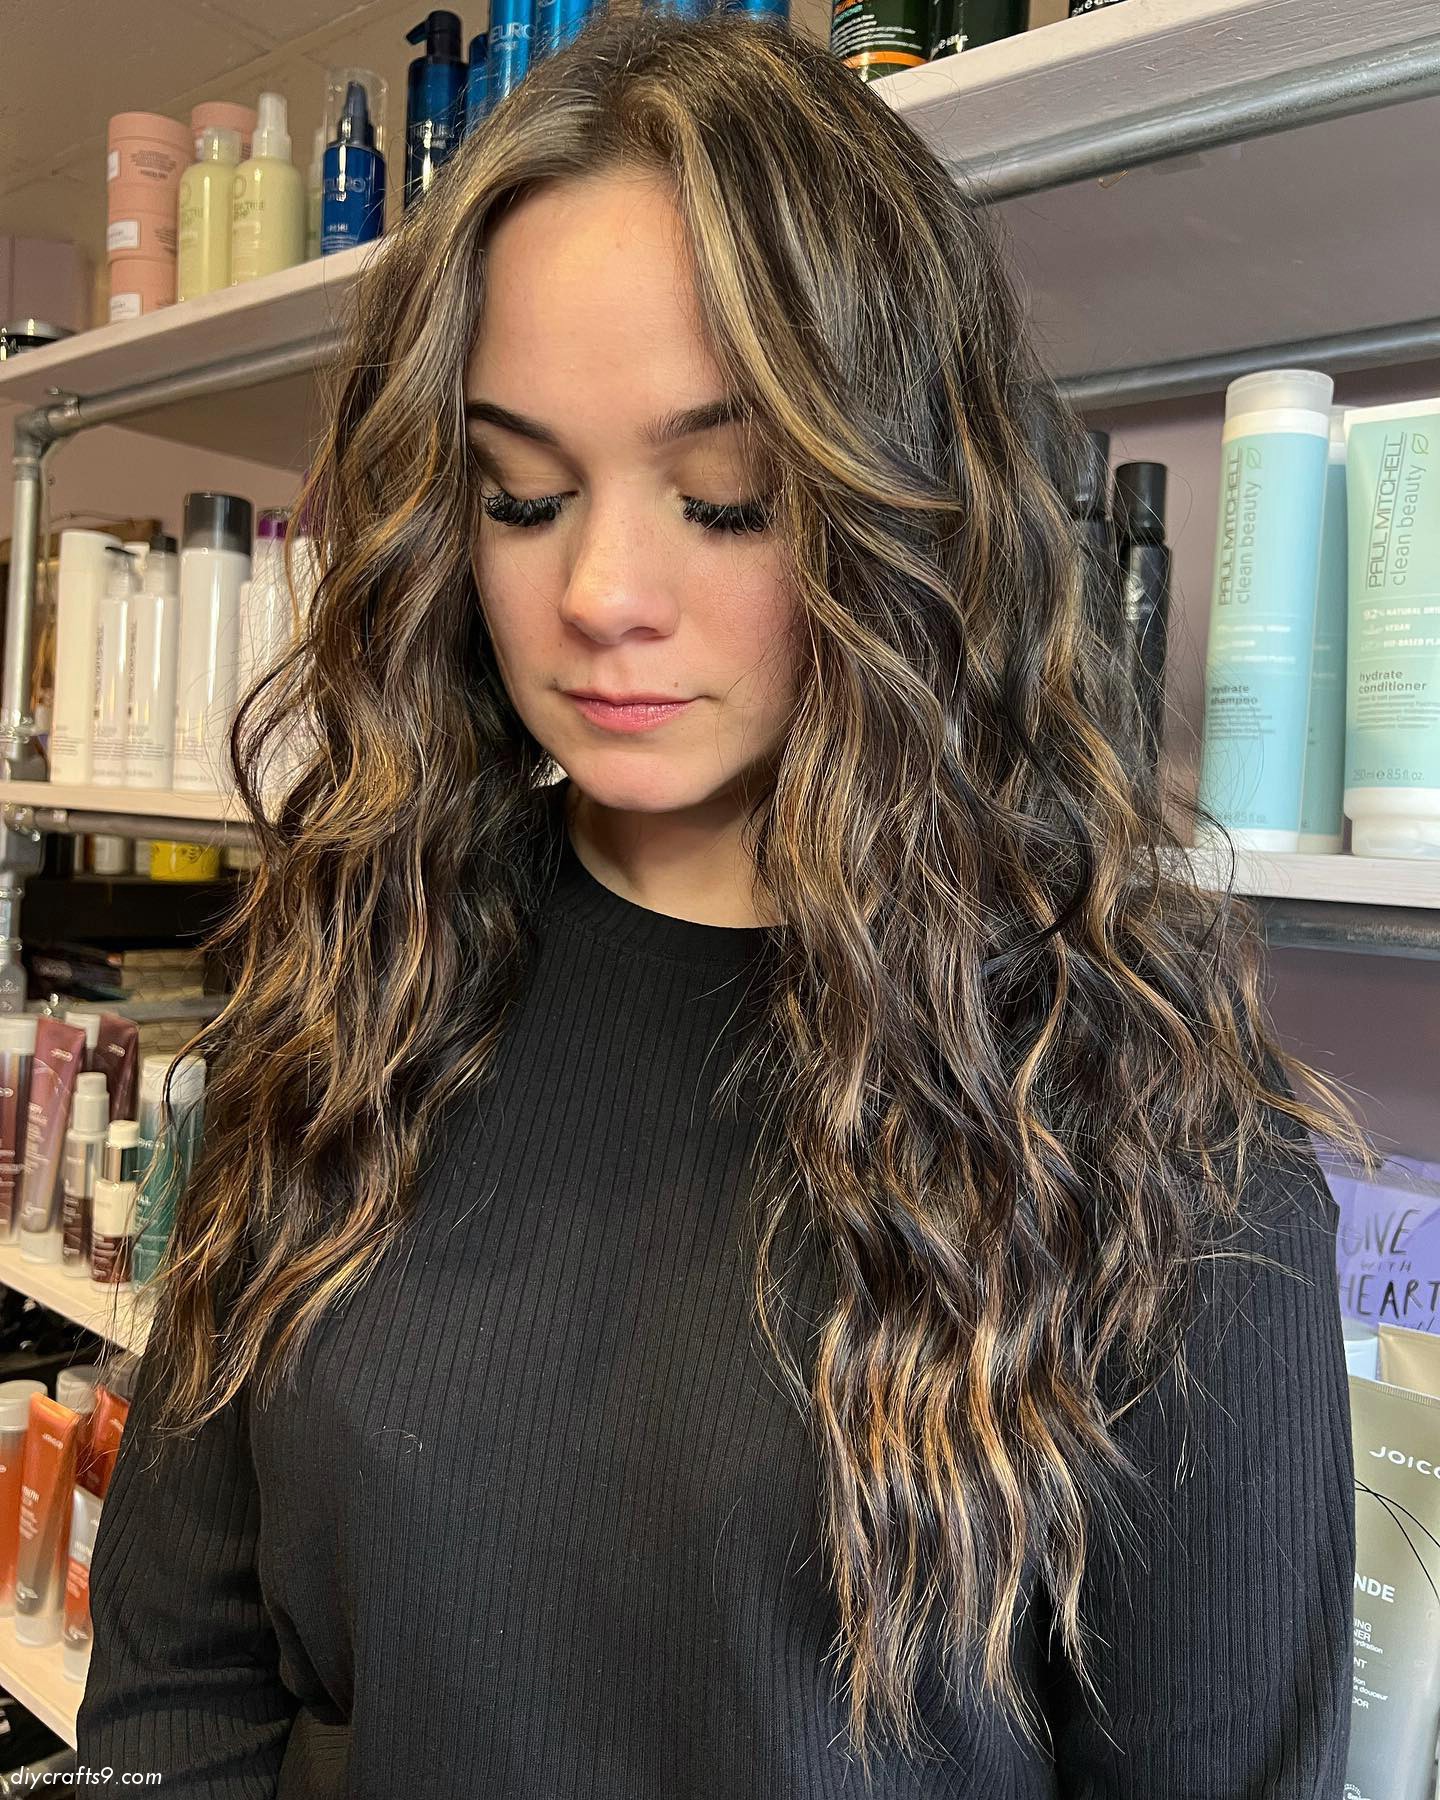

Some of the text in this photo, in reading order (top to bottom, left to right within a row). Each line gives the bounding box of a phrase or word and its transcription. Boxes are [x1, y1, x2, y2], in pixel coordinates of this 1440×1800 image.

[1217, 446, 1241, 606] PAUL MITCHELL
[1236, 481, 1263, 605] clean beauty
[1368, 431, 1405, 588] PAUL MITCHELL
[1390, 464, 1428, 586] clean beauty
[1359, 681, 1427, 694] conditioner
[1360, 670, 1403, 683] hydrate
[1342, 1209, 1421, 1256] GIVE
[1338, 1274, 1440, 1319] HEART
